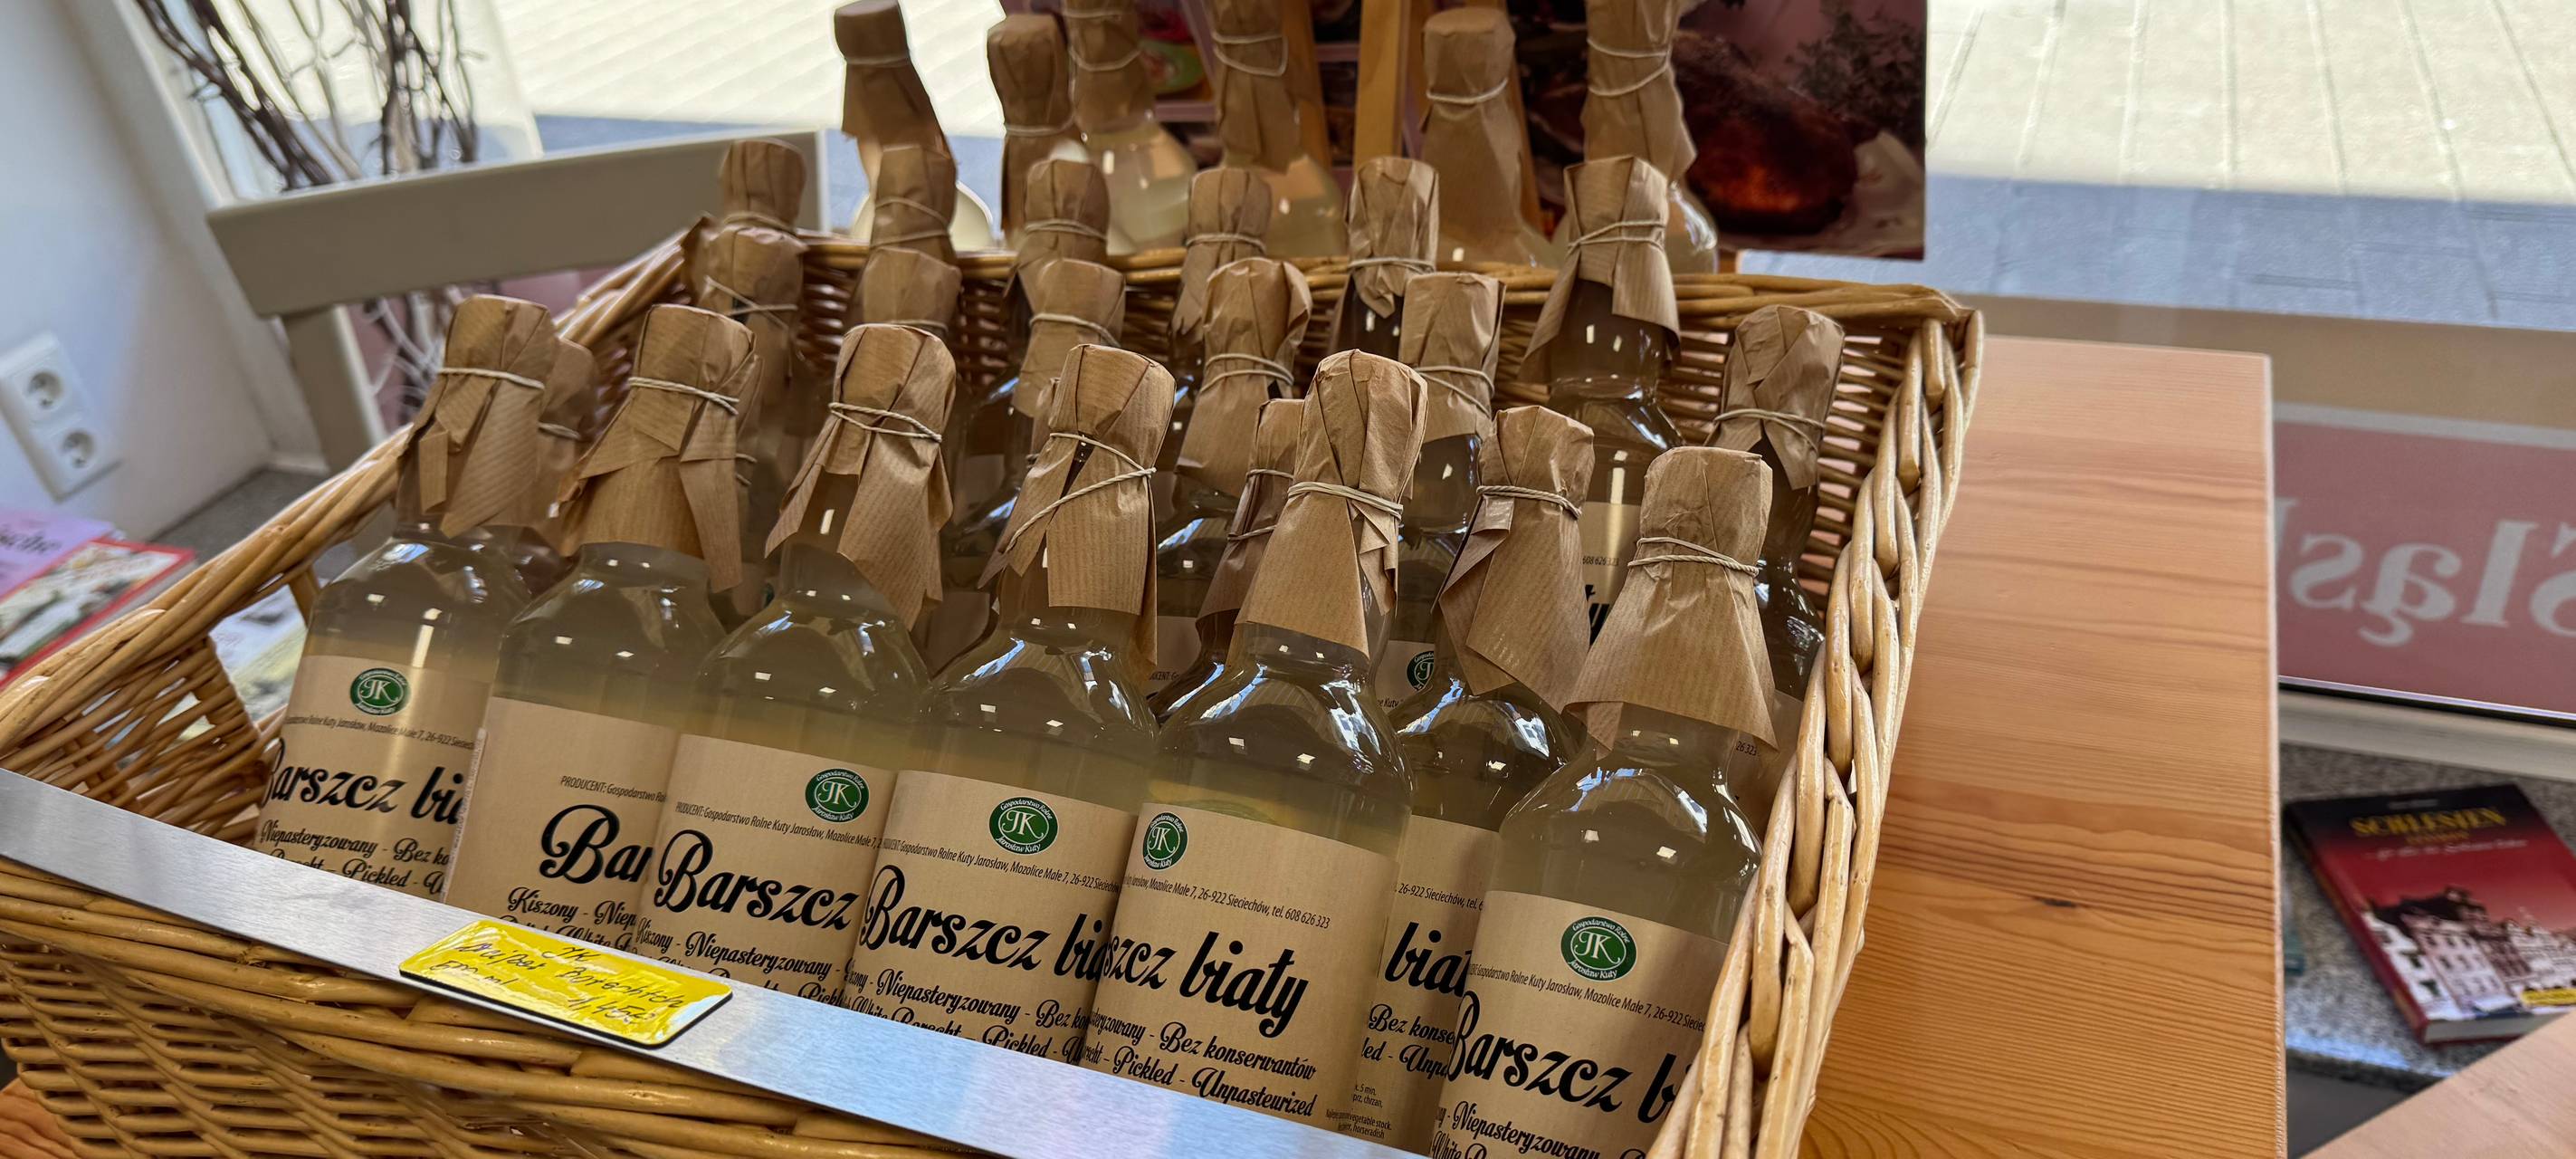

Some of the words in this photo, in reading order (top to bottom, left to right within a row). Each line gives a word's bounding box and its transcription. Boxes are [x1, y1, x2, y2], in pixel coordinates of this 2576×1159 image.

[359, 678, 400, 704] JK
[560, 775, 606, 795] PRODUCENT:
[606, 783, 655, 802] Gospodarstwo
[816, 781, 857, 809] JK
[260, 819, 378, 858] Niepasteryzowany
[393, 838, 431, 864] Bez
[703, 808, 751, 828] Gospodarstwo
[750, 815, 772, 830] Rolne
[772, 819, 790, 835] Kuty
[789, 822, 825, 841] Jarosław,
[825, 829, 856, 845] Mozolice
[854, 835, 873, 848] Małe
[1001, 809, 1045, 839] JK
[1148, 827, 1176, 854] JK
[654, 829, 861, 932] Barszcz
[900, 839, 938, 857] Gospodarstwo
[938, 847, 958, 862] Rolne
[957, 850, 976, 867] Kuty
[974, 854, 1009, 873] Jarosław,
[1009, 863, 1044, 878] Mozolice
[1045, 868, 1064, 882] Małe
[1062, 871, 1071, 886] 7,
[1070, 873, 1094, 889] 26-922
[507, 886, 579, 924] Kiszony
[1172, 881, 1190, 896] Małe
[1189, 886, 1198, 900] 7,
[1197, 887, 1227, 905] 26-922
[1226, 894, 1271, 916] Sieciechów,
[1271, 904, 1284, 918] tel.
[1284, 907, 1302, 923] 608
[1301, 910, 1317, 926] 626
[1316, 914, 1331, 930] 323
[1398, 883, 1425, 899] 26-922
[1424, 886, 1466, 908] Sieciechów,
[1465, 897, 1478, 909] tel.
[859, 864, 1052, 972] Barszcz
[635, 916, 674, 953] Kiszony
[685, 930, 833, 982] Niepasteryzowany
[1573, 930, 1621, 965] JK
[876, 968, 1022, 1025] Niepasteryzowany
[1035, 999, 1070, 1030] Bez
[1179, 931, 1310, 1039] biały
[1509, 969, 1529, 987] Rolne
[1528, 972, 1546, 992] Kuty
[1545, 977, 1583, 1000] Jarosław,
[1583, 988, 1622, 1009] Mozolice
[1621, 995, 1644, 1014] Małe
[1643, 1002, 1653, 1019] 7,
[1653, 1005, 1684, 1026] 26-922
[1368, 1003, 1407, 1034] Bez
[981, 1024, 1054, 1058] Pickled
[1159, 1021, 1201, 1055] Bez
[1202, 1035, 1317, 1081] konserwantów
[1448, 990, 1634, 1114] Barszcz
[1112, 1045, 1178, 1087] Pickled
[1191, 1067, 1319, 1117] Unpasteurized
[1376, 1120, 1392, 1130] stock.
